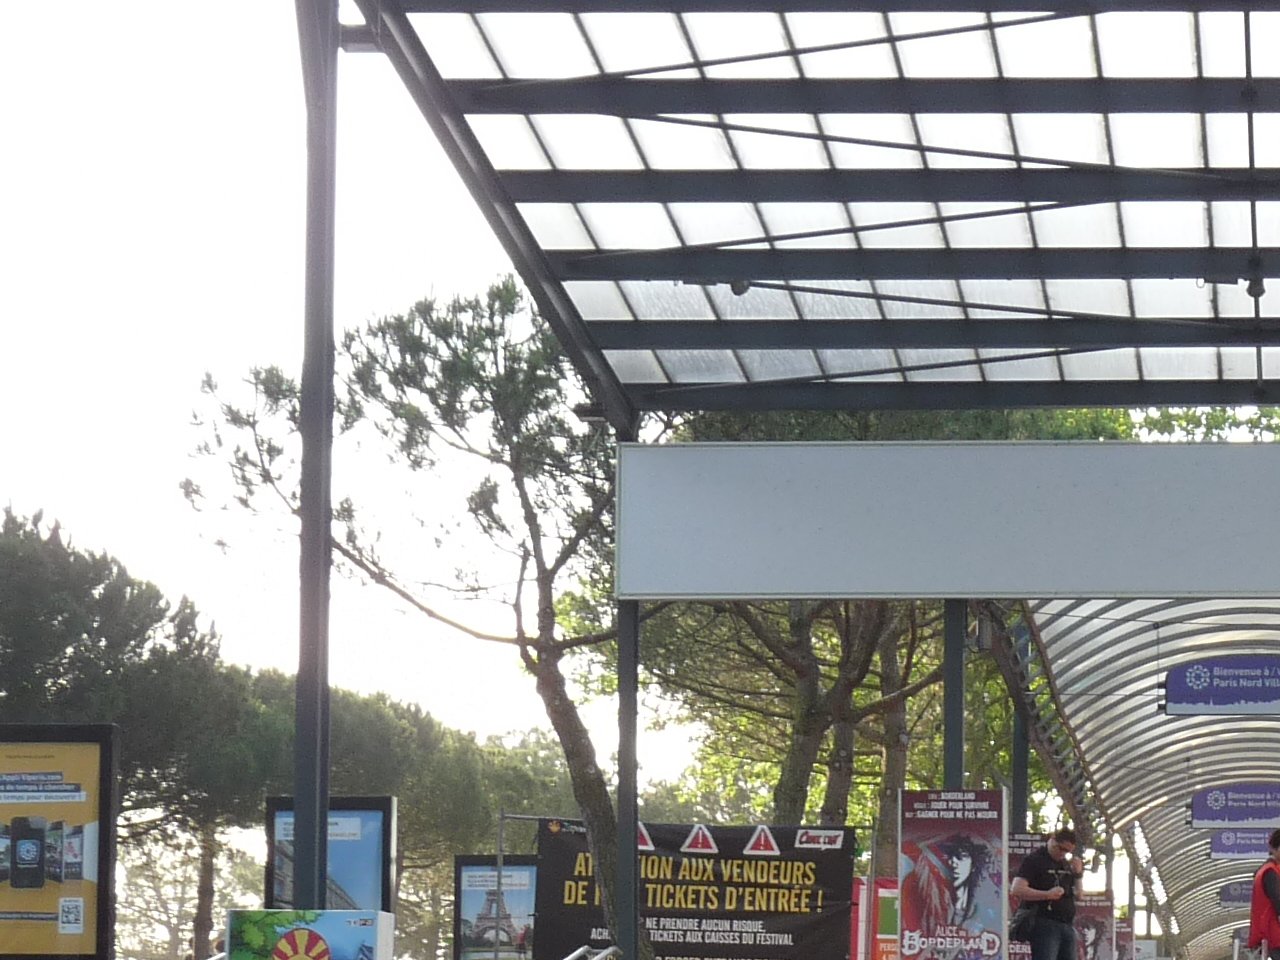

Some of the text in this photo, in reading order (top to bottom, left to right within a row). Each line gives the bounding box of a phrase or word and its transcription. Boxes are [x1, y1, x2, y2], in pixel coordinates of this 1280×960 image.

[1213, 667, 1262, 677] Bienvenue
[1213, 679, 1237, 688] Paris
[1239, 679, 1263, 688] Nord
[679, 857, 714, 881] AUX
[720, 859, 817, 886] VENDEURS
[563, 880, 589, 905] DE
[645, 883, 719, 911] TICKETS
[725, 884, 812, 913] D'ENTRÉE
[816, 889, 824, 913] !
[645, 917, 658, 929] NE
[660, 918, 699, 931] PRENDRE
[701, 919, 730, 931] AUCUN
[935, 925, 959, 937] ALICE
[649, 930, 794, 946] TICKETS AUX CAISSES DU FESTIVAL
